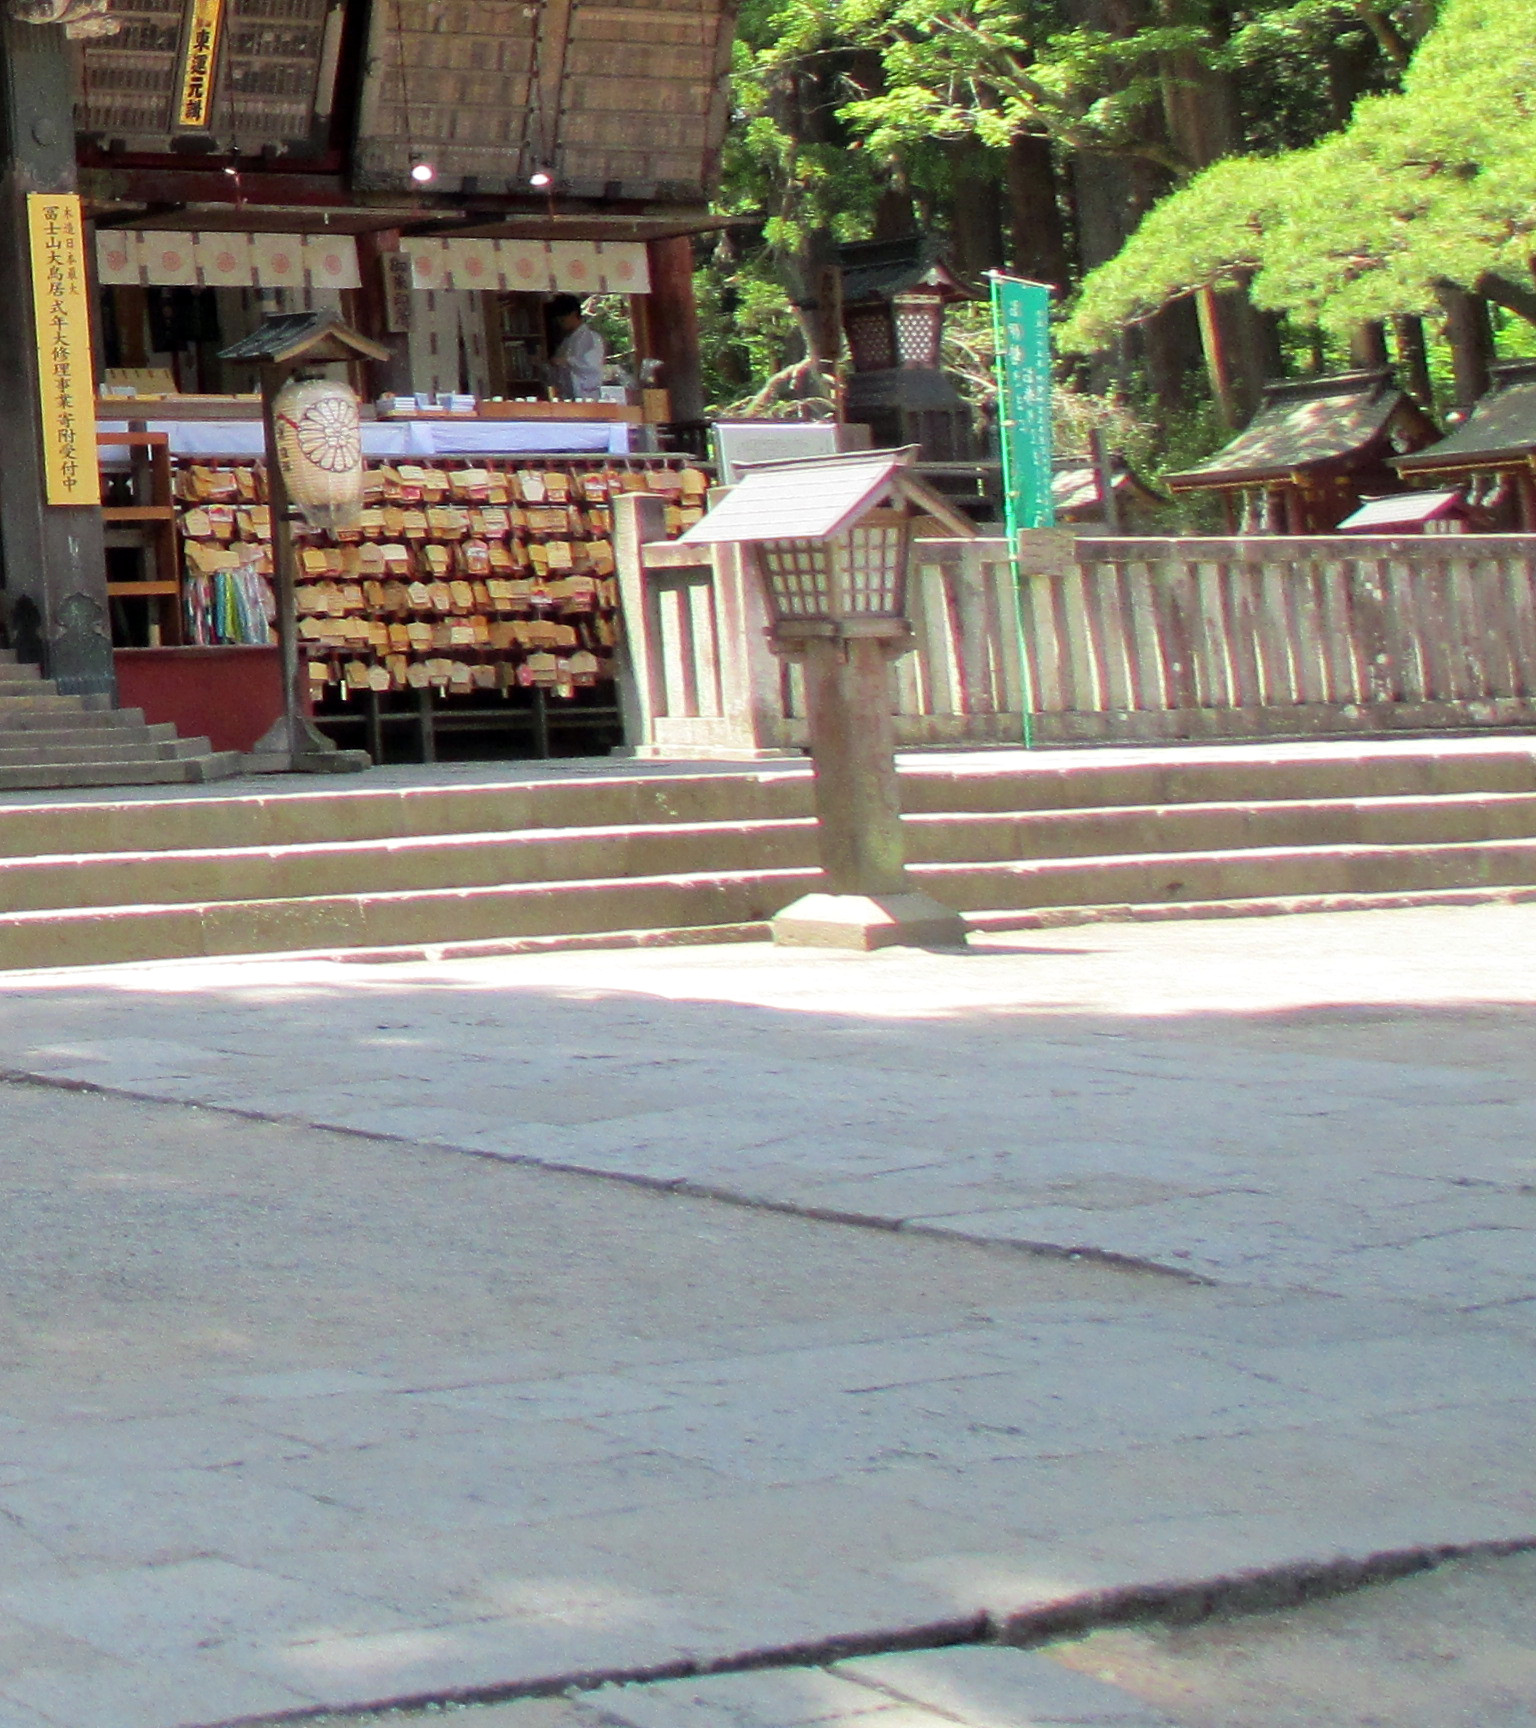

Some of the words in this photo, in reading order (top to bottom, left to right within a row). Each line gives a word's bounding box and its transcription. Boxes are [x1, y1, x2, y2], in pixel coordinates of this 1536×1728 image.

[62, 205, 80, 296] 木造日本最大
